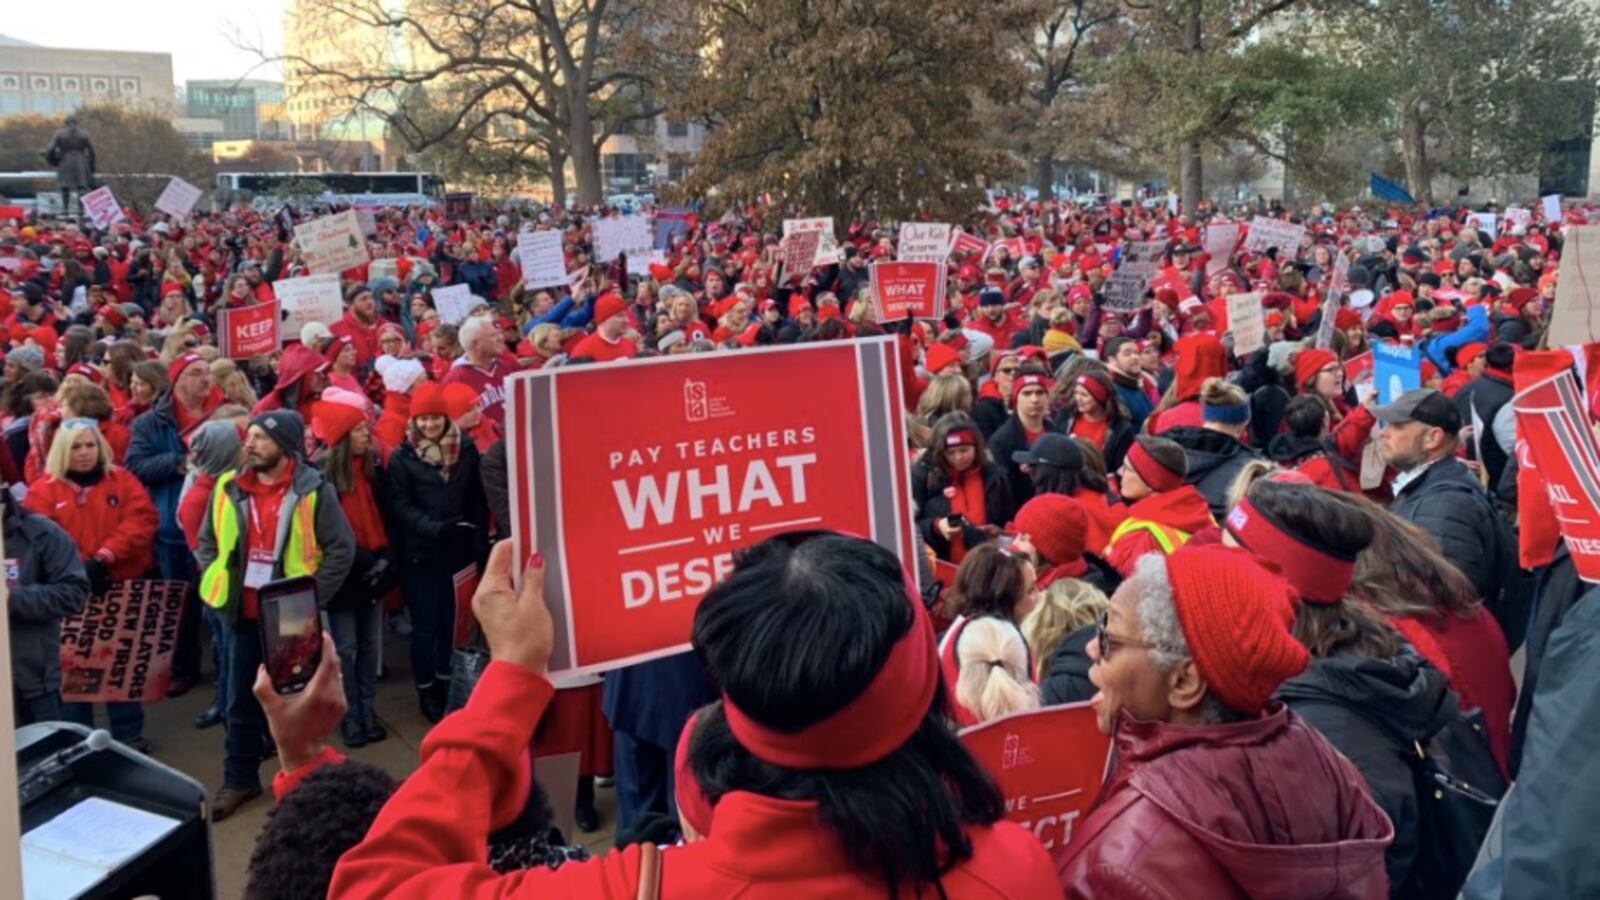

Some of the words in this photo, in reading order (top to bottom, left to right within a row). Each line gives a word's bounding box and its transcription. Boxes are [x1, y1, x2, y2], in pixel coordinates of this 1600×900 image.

[884, 284, 925, 297] WHAT
[609, 446, 662, 469] PAY
[675, 426, 816, 459] TEACHERS
[611, 453, 817, 531] WHAT
[703, 523, 742, 545] WE
[122, 580, 145, 631] DREW
[620, 552, 736, 609] DESE
[74, 595, 105, 659] GAINST
[128, 580, 164, 699] LEGISLATORS
[156, 581, 185, 655] INDIANA
[107, 637, 134, 689] FIRST
